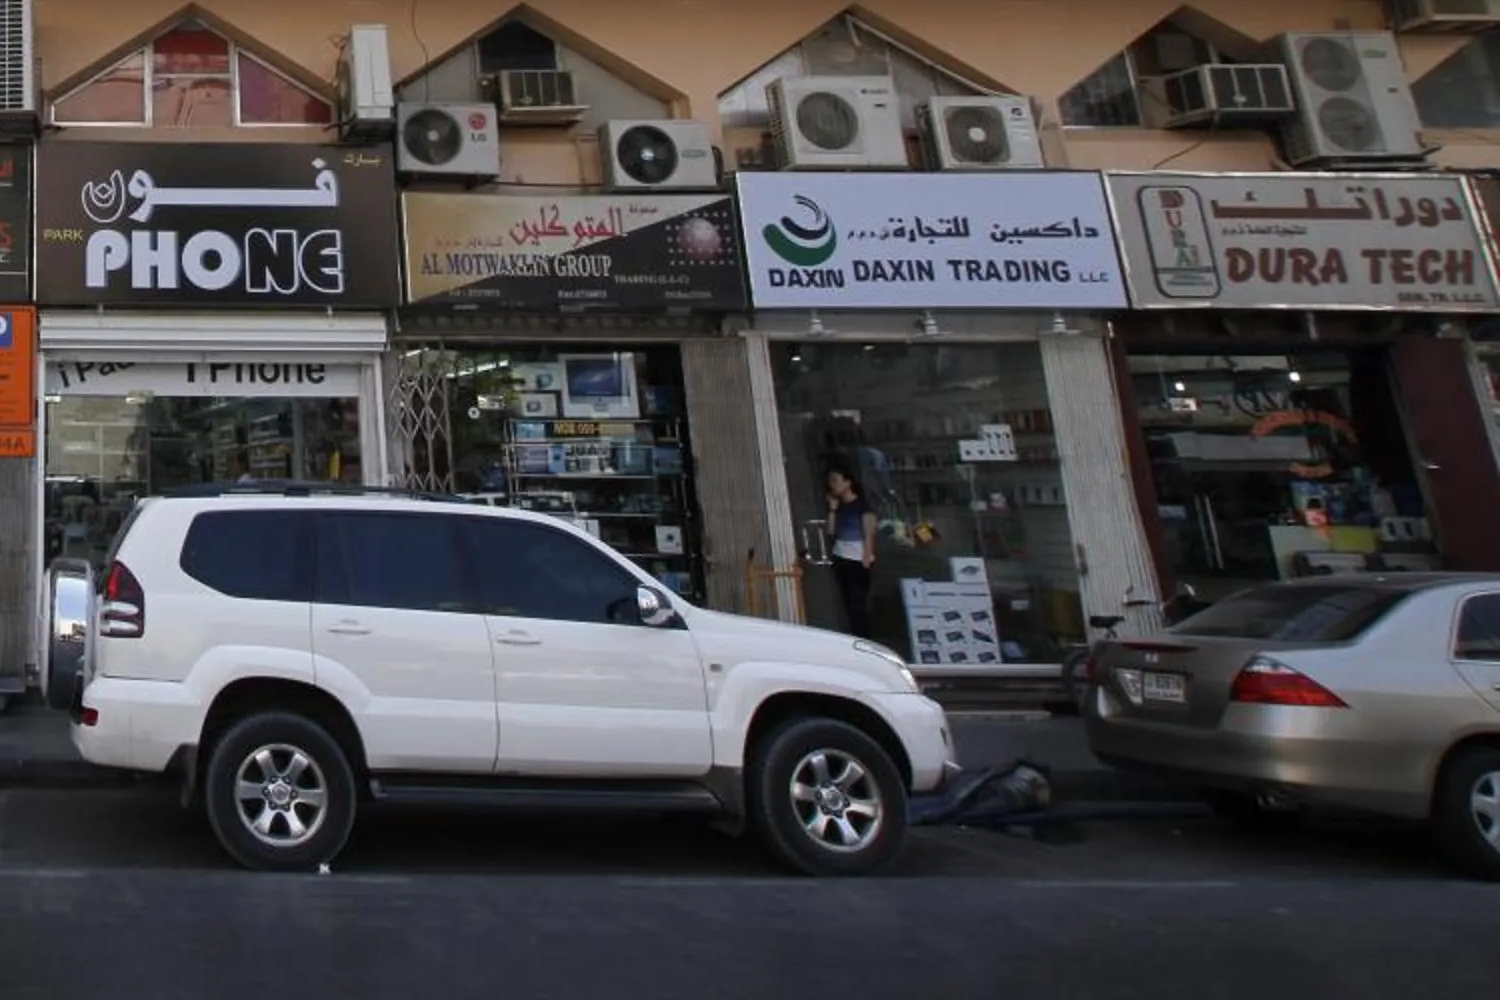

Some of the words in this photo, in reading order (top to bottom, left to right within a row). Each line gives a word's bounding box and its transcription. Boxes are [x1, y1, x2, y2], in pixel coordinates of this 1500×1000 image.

[81, 156, 339, 223] فون
[508, 204, 624, 247] المتوكلين
[888, 216, 970, 245] للتجارة
[989, 217, 1099, 244] داكسين
[43, 228, 84, 242] PARK
[85, 227, 344, 295] PHONE
[421, 252, 443, 275] AL
[553, 253, 613, 278] GROUP
[852, 259, 935, 283] DAXIN
[948, 260, 1071, 284] TRADING
[1224, 247, 1348, 286] DURA
[1361, 248, 1474, 285] TECH
[768, 267, 845, 289] DAXIN
